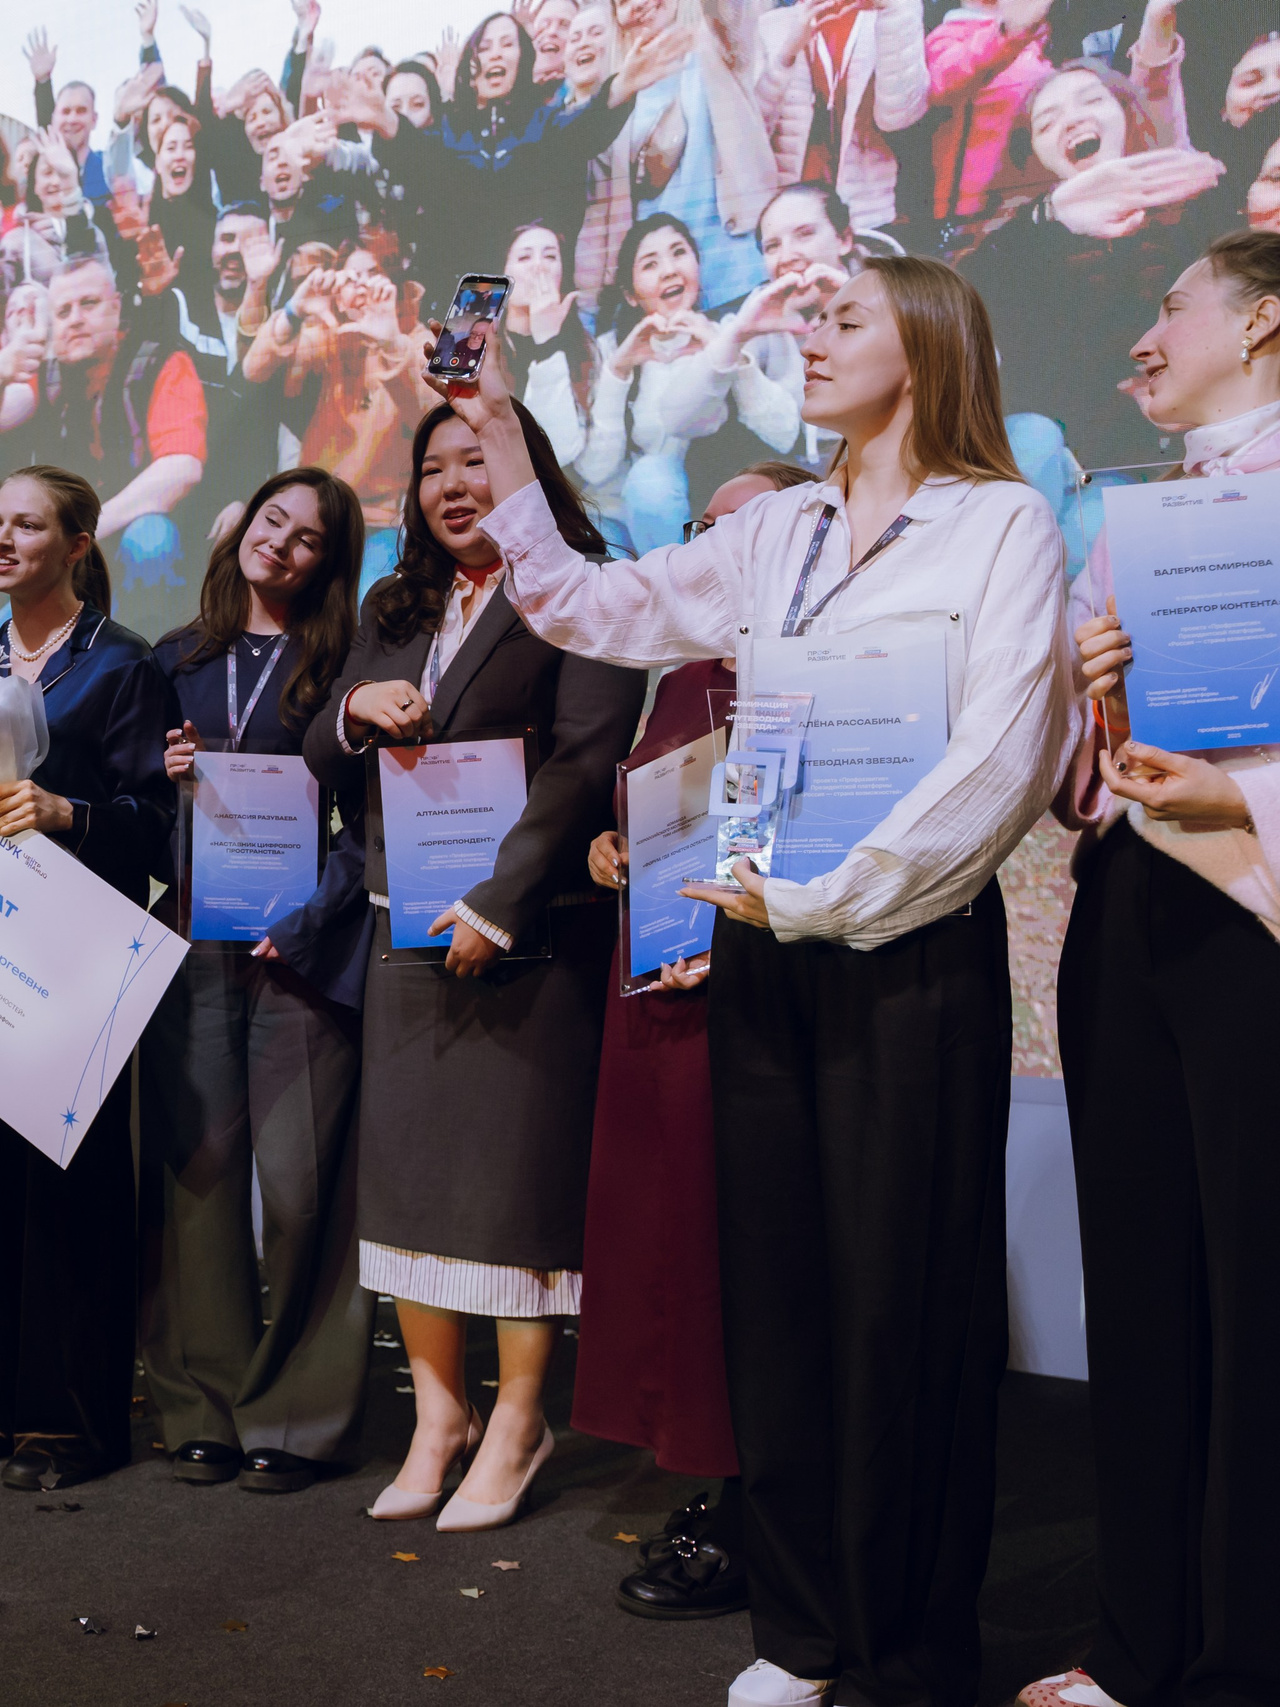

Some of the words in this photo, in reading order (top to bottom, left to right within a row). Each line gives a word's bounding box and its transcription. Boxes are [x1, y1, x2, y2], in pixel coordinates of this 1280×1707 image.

[1162, 499, 1203, 508] РАЗВИТИЕ
[1154, 565, 1206, 577] ВАЛЕРИЯ
[1209, 559, 1273, 572] СМИРНОВА
[1151, 605, 1218, 617] «ГЕНЕРАТОР
[1229, 627, 1265, 636] платформы
[807, 648, 831, 656] ПРОФ
[807, 654, 846, 662] РАЗВИТИЕ
[729, 700, 789, 709] НОМИНАЦИЯ
[798, 716, 835, 728] АЛЁНА
[836, 717, 901, 727] РАССАБИНА
[800, 758, 864, 768] УТЕВОДНАЯ
[866, 756, 915, 766] ЗВЕЗДА»
[838, 776, 889, 784] «Профразвитие»
[416, 809, 450, 818] АЛТАНА
[450, 806, 495, 816] БИМБЕЕВА
[214, 813, 257, 821] АНАСТАСИЯ
[257, 814, 298, 822] РАЗУВАЕВА
[210, 841, 257, 849] «НАСТАВНИК
[257, 843, 301, 851] ЦИФРОВОГО
[417, 836, 496, 847] «КОРРЕСПОНДЕНТ»
[226, 848, 285, 856] ПРОСТРАНСТВА»
[23, 853, 41, 869] ЦЕНТР
